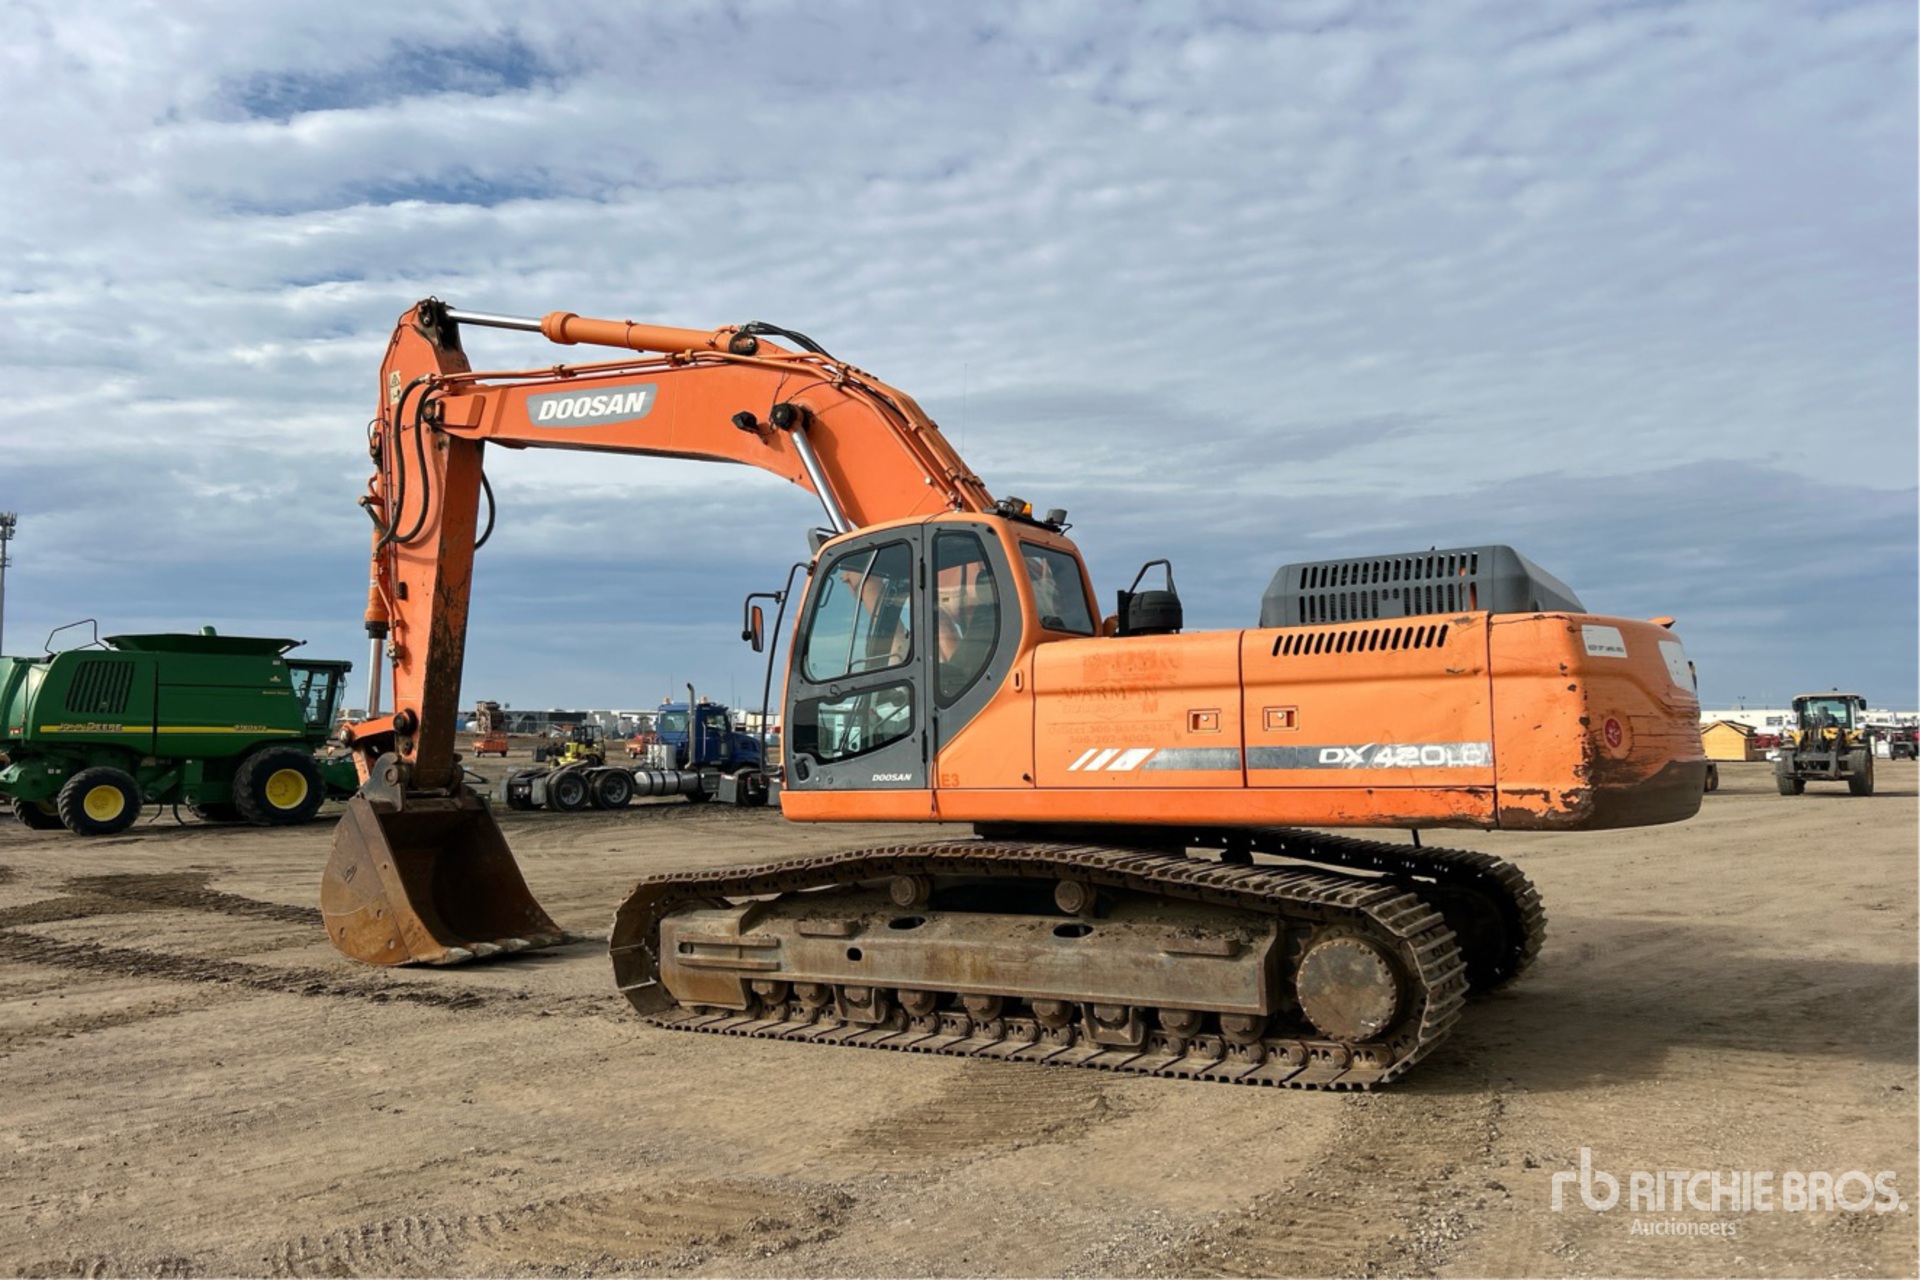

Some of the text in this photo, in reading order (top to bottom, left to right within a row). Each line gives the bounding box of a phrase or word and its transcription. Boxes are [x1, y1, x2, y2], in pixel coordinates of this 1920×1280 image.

[537, 391, 647, 421] DOOSAN
[1318, 742, 1375, 766] DX
[871, 773, 912, 782] DOOSAN
[941, 773, 960, 787] E3
